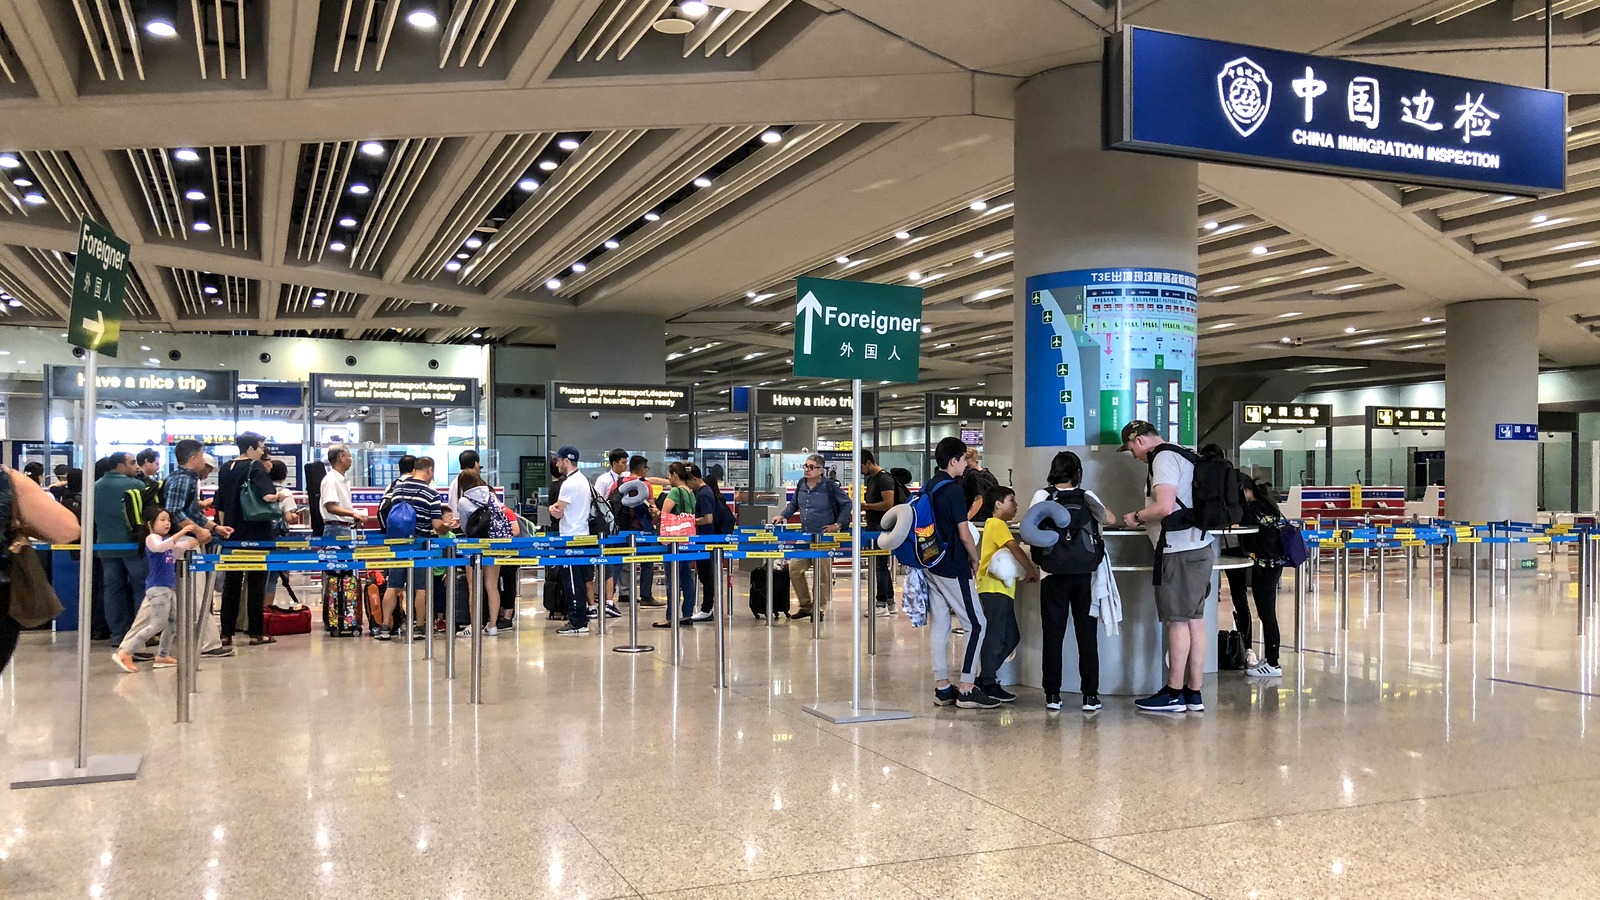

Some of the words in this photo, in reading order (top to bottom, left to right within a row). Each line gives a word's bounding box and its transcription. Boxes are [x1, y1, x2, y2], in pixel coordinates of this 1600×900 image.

[1292, 66, 1500, 143] 中国边检
[1292, 129, 1335, 149] CHINA
[1338, 135, 1424, 160] IMMIGRATION
[1427, 146, 1500, 169] INSPECTION
[81, 223, 126, 270] Foreigner
[83, 272, 112, 303] 外国人
[825, 306, 921, 335] Foreigner
[840, 341, 901, 361] 外国人
[125, 376, 136, 389] a
[139, 374, 175, 390] nice
[178, 375, 207, 393] trip
[323, 379, 353, 388] Please
[353, 380, 369, 390] get
[369, 381, 389, 390] your
[559, 386, 585, 395] Please
[586, 387, 599, 396] get
[599, 389, 617, 397] your
[334, 389, 354, 398] card
[355, 389, 372, 398] and
[373, 390, 411, 401] boarding
[411, 392, 431, 401] pass
[432, 391, 457, 402] ready
[569, 396, 587, 404] card
[587, 396, 602, 404] and
[603, 396, 636, 407] boarding
[636, 399, 654, 407] pass
[654, 398, 676, 408] ready
[772, 393, 801, 406] Have
[803, 397, 811, 407] a
[813, 395, 837, 407] nice
